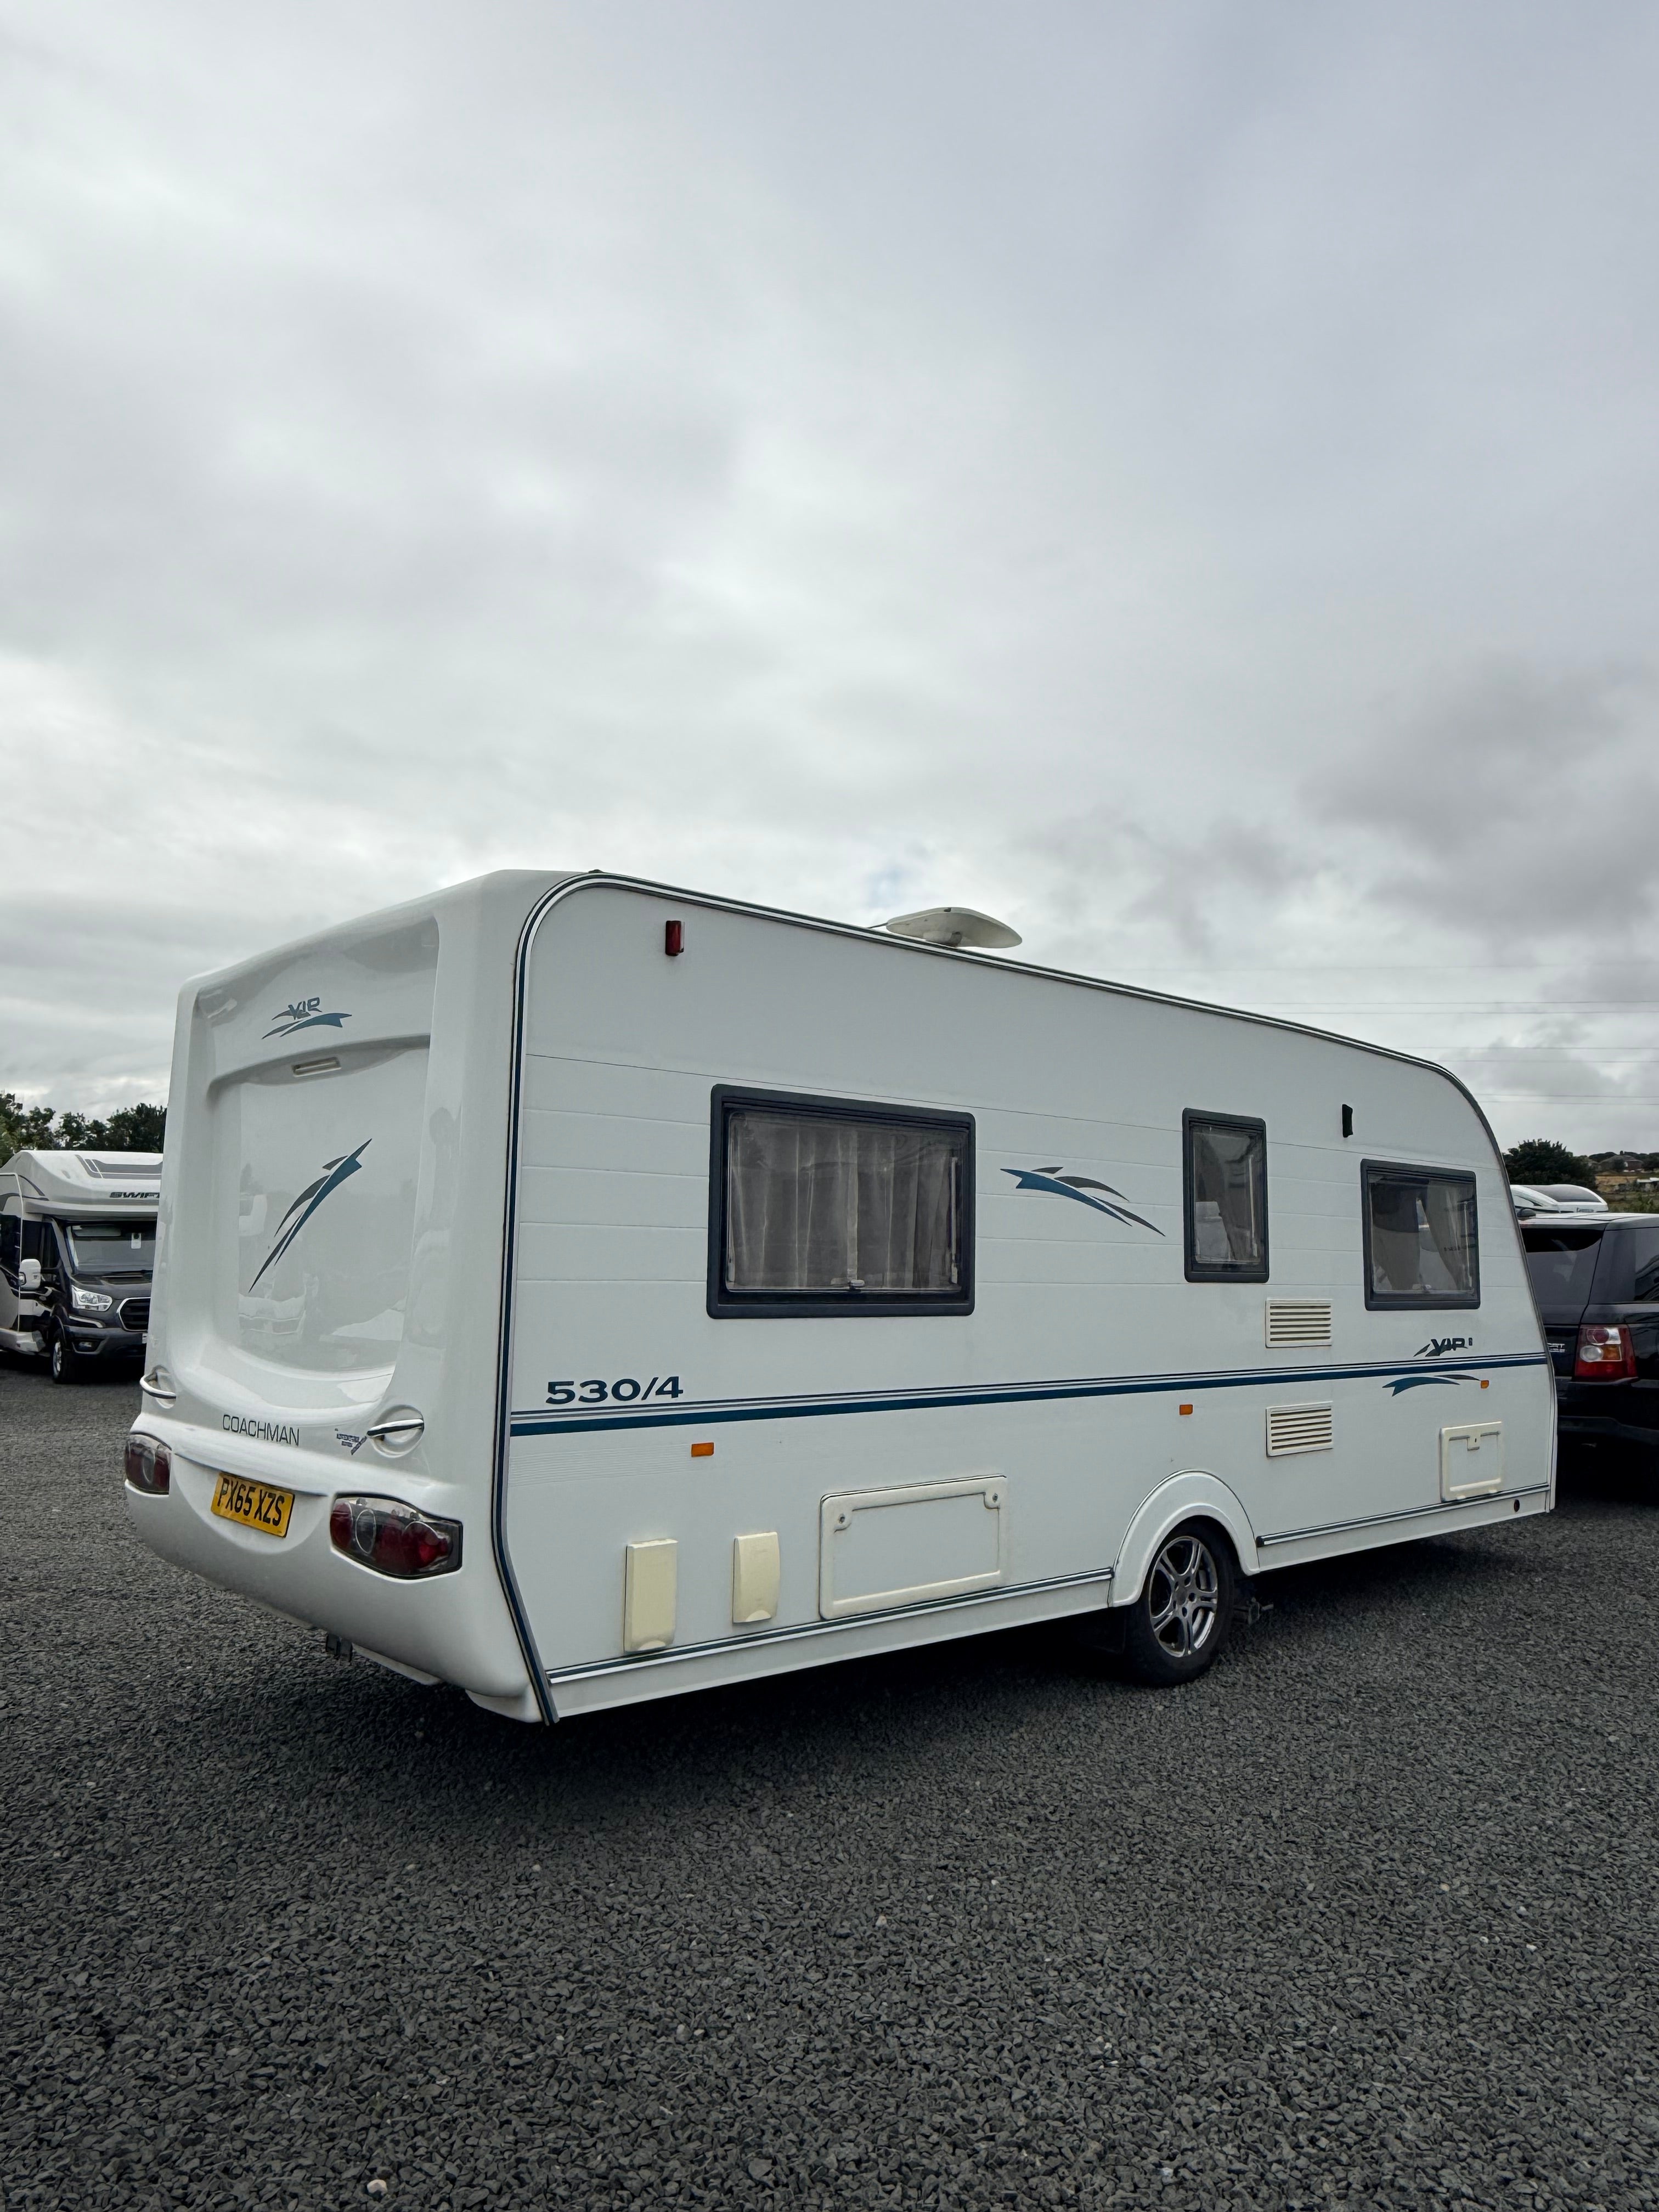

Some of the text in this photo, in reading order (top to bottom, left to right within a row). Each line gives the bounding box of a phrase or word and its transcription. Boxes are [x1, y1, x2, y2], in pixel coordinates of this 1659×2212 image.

[287, 997, 323, 1020] VIP
[1426, 1338, 1468, 1356] VIP
[546, 1376, 684, 1404] 530/4
[223, 1414, 299, 1446] COACHMAN
[217, 1477, 285, 1526] PX65 XZS
